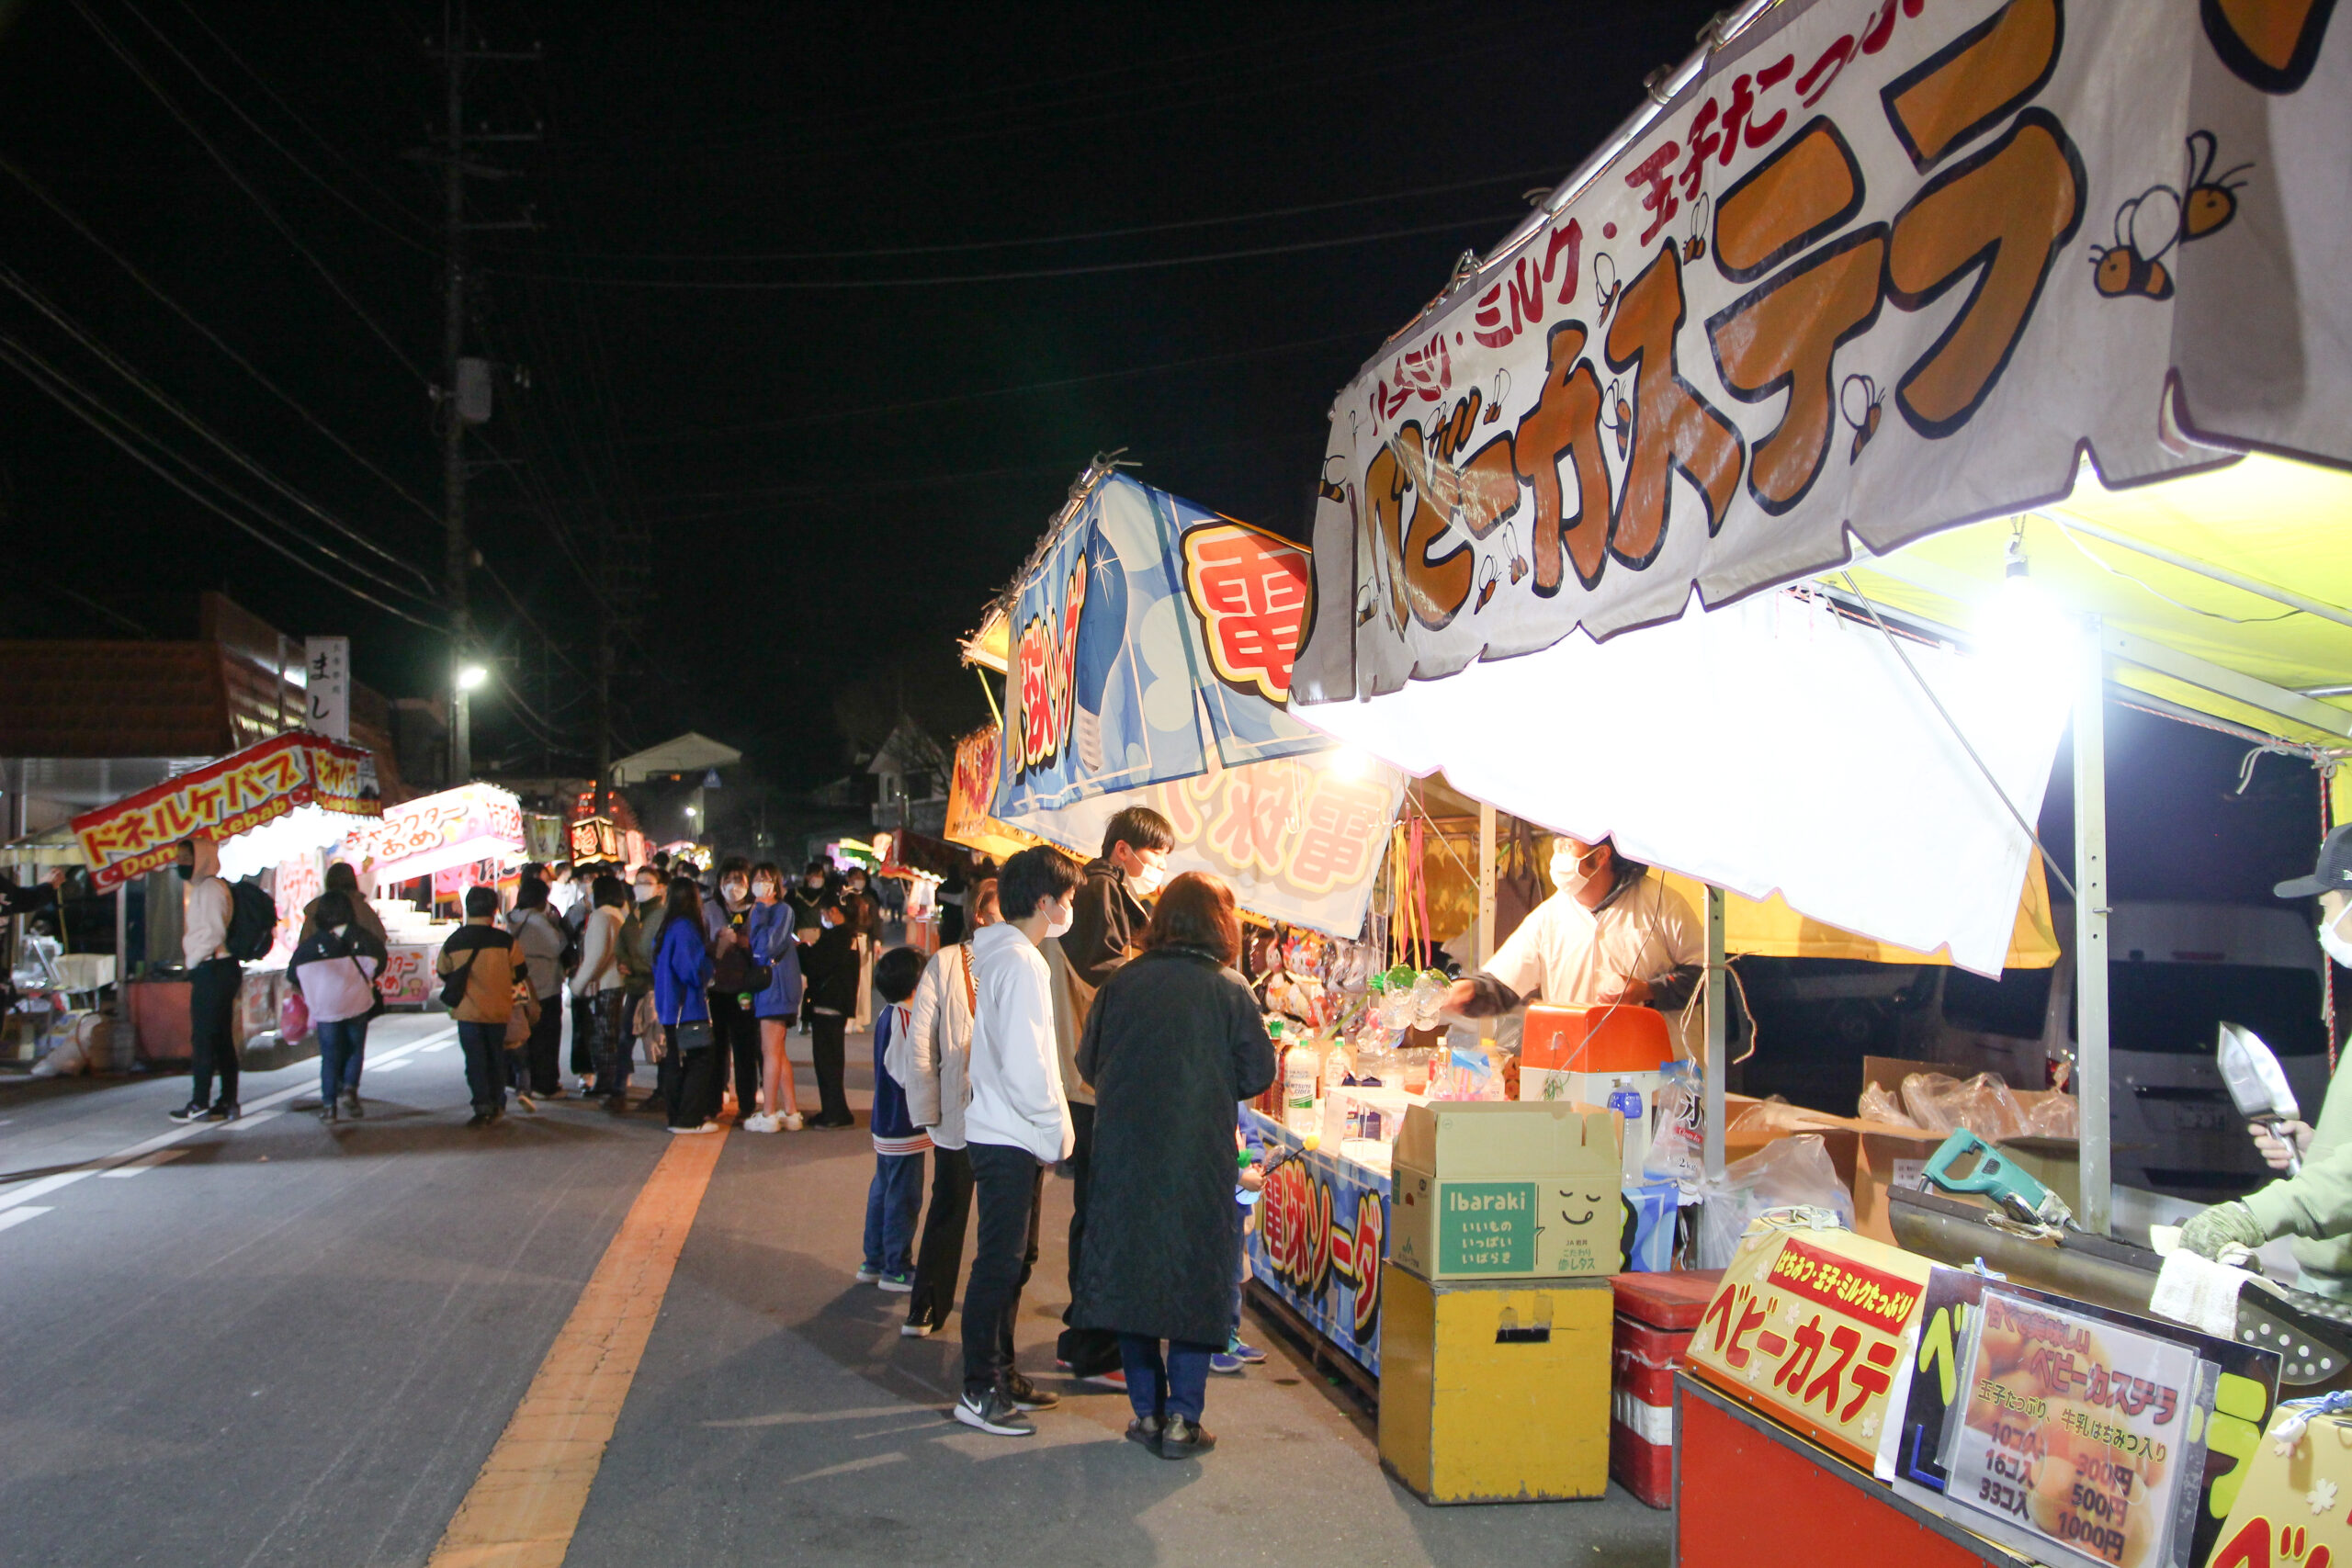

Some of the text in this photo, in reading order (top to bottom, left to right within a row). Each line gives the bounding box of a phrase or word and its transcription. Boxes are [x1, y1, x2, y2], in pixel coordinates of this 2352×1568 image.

[1363, 0, 2087, 641] ベビーカステラ
[84, 750, 306, 870] ドネルケバブ
[120, 834, 189, 877] Don
[209, 797, 287, 841] Kebab
[381, 829, 436, 856] あめ
[1450, 1191, 1526, 1212] Ibaraki
[1462, 1221, 1512, 1233] いいもの
[1262, 1157, 1383, 1332] 電球ソーダ
[1462, 1236, 1512, 1248] いっぱい
[1462, 1251, 1511, 1265] いばらき
[1774, 1250, 1915, 1323] はちみつ・玉子・ミルクたっぷり
[1985, 1299, 2091, 1355] 甘くて美味しい
[2031, 1348, 2179, 1425] ベビーカステラ
[1985, 1449, 2129, 1528] 16コ入 500円
[2075, 1451, 2134, 1498] 300円
[1978, 1476, 2126, 1562] 33コ入 1000円
